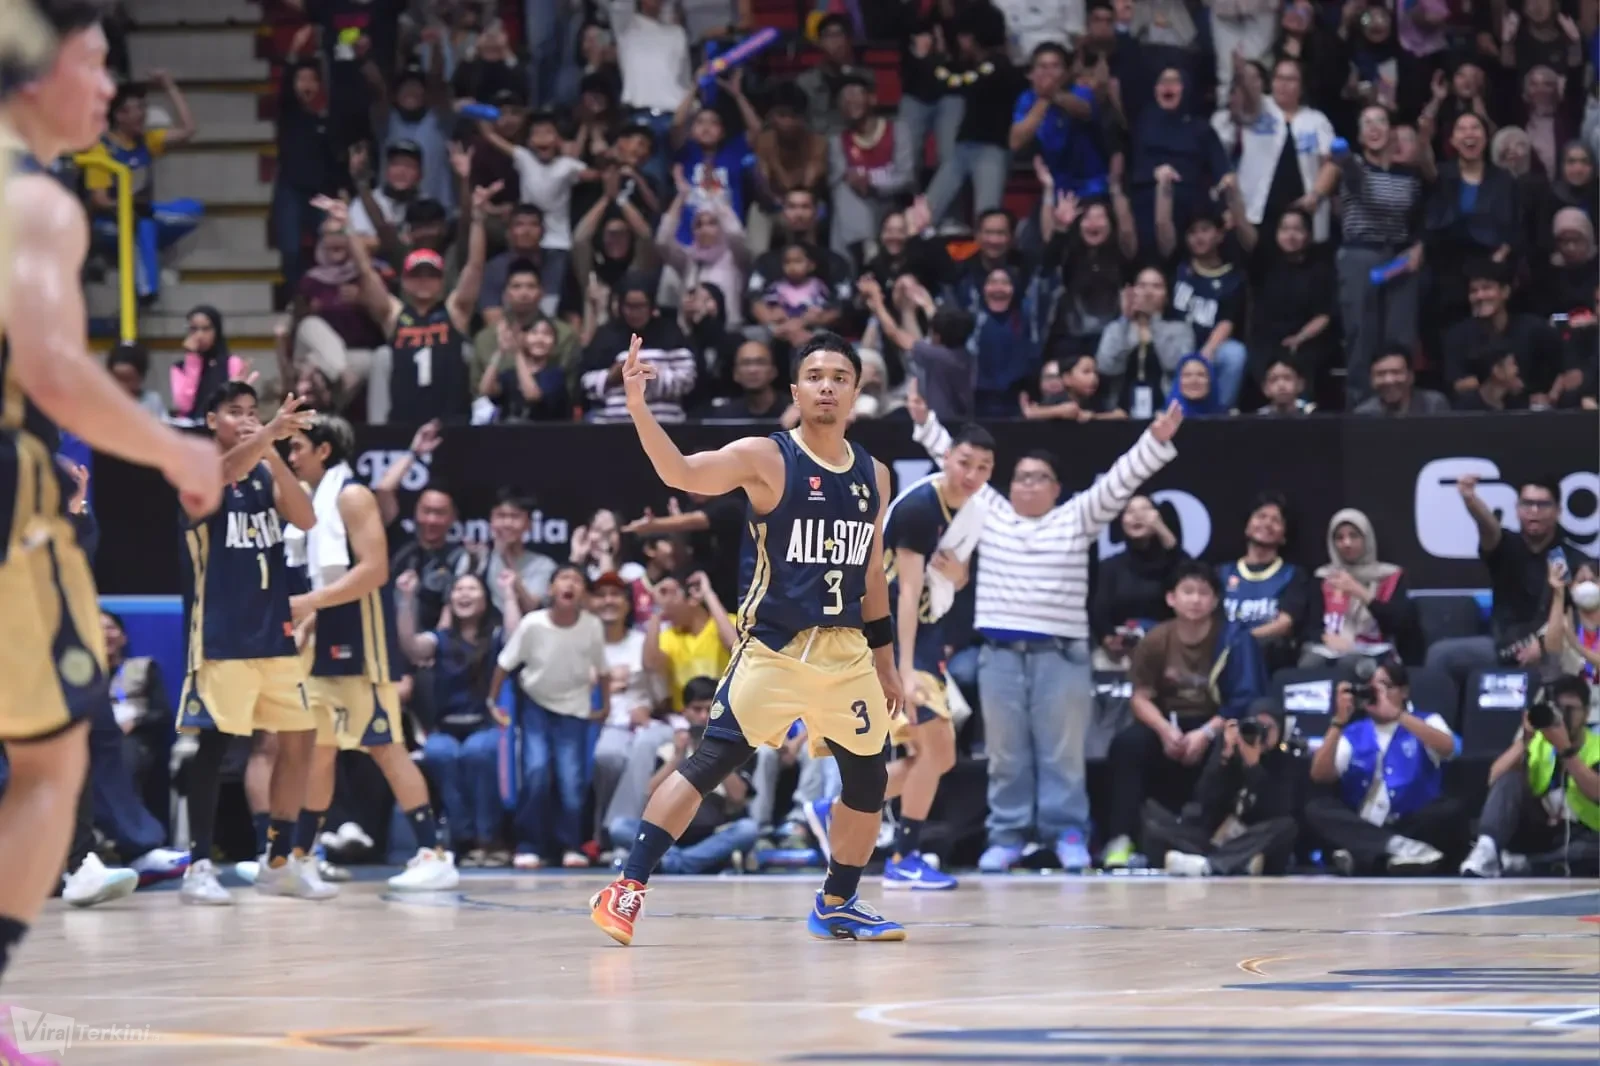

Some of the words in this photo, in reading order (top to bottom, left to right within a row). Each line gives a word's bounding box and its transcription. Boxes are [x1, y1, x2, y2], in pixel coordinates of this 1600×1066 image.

[413, 347, 432, 387] 1
[256, 551, 269, 590] 1
[823, 570, 844, 616] 3
[850, 700, 871, 735] 3
